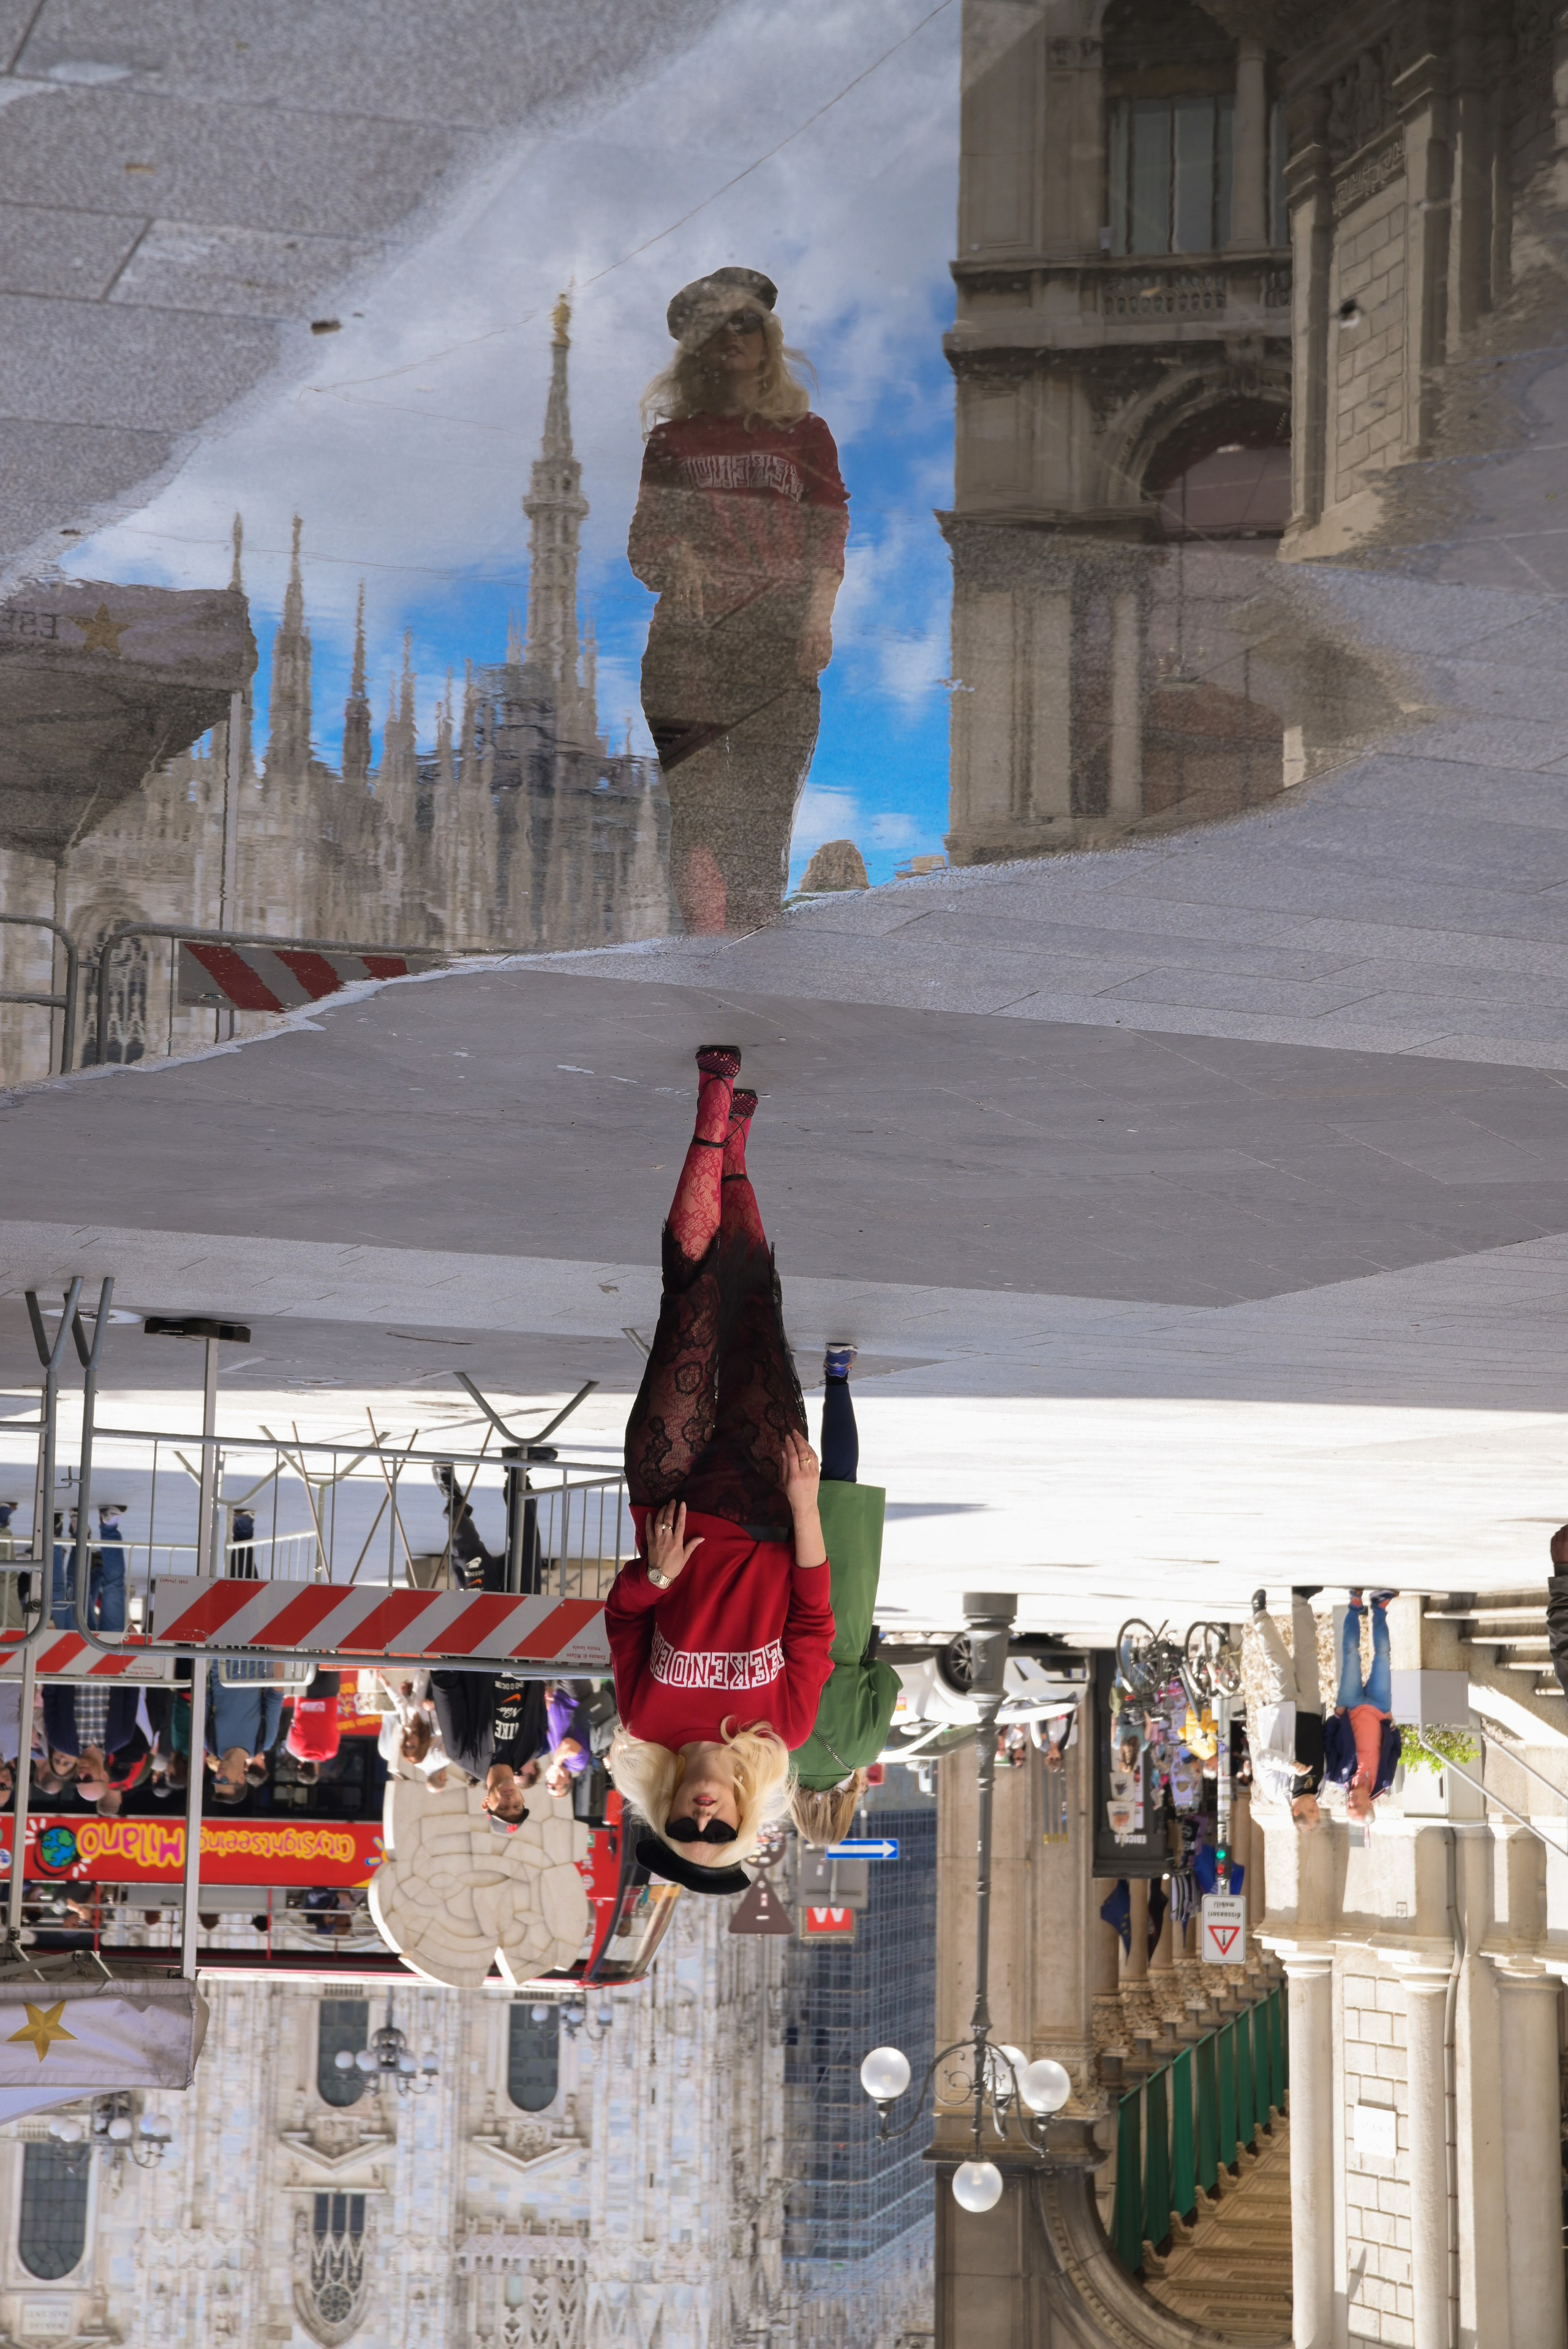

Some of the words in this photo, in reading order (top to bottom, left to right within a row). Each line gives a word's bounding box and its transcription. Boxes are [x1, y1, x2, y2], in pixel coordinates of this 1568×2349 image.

[494, 1680, 524, 1691] NIKE
[496, 1707, 523, 1719] Nike
[1114, 1834, 1147, 1844] EDICOA
[78, 1825, 183, 1866] Milano
